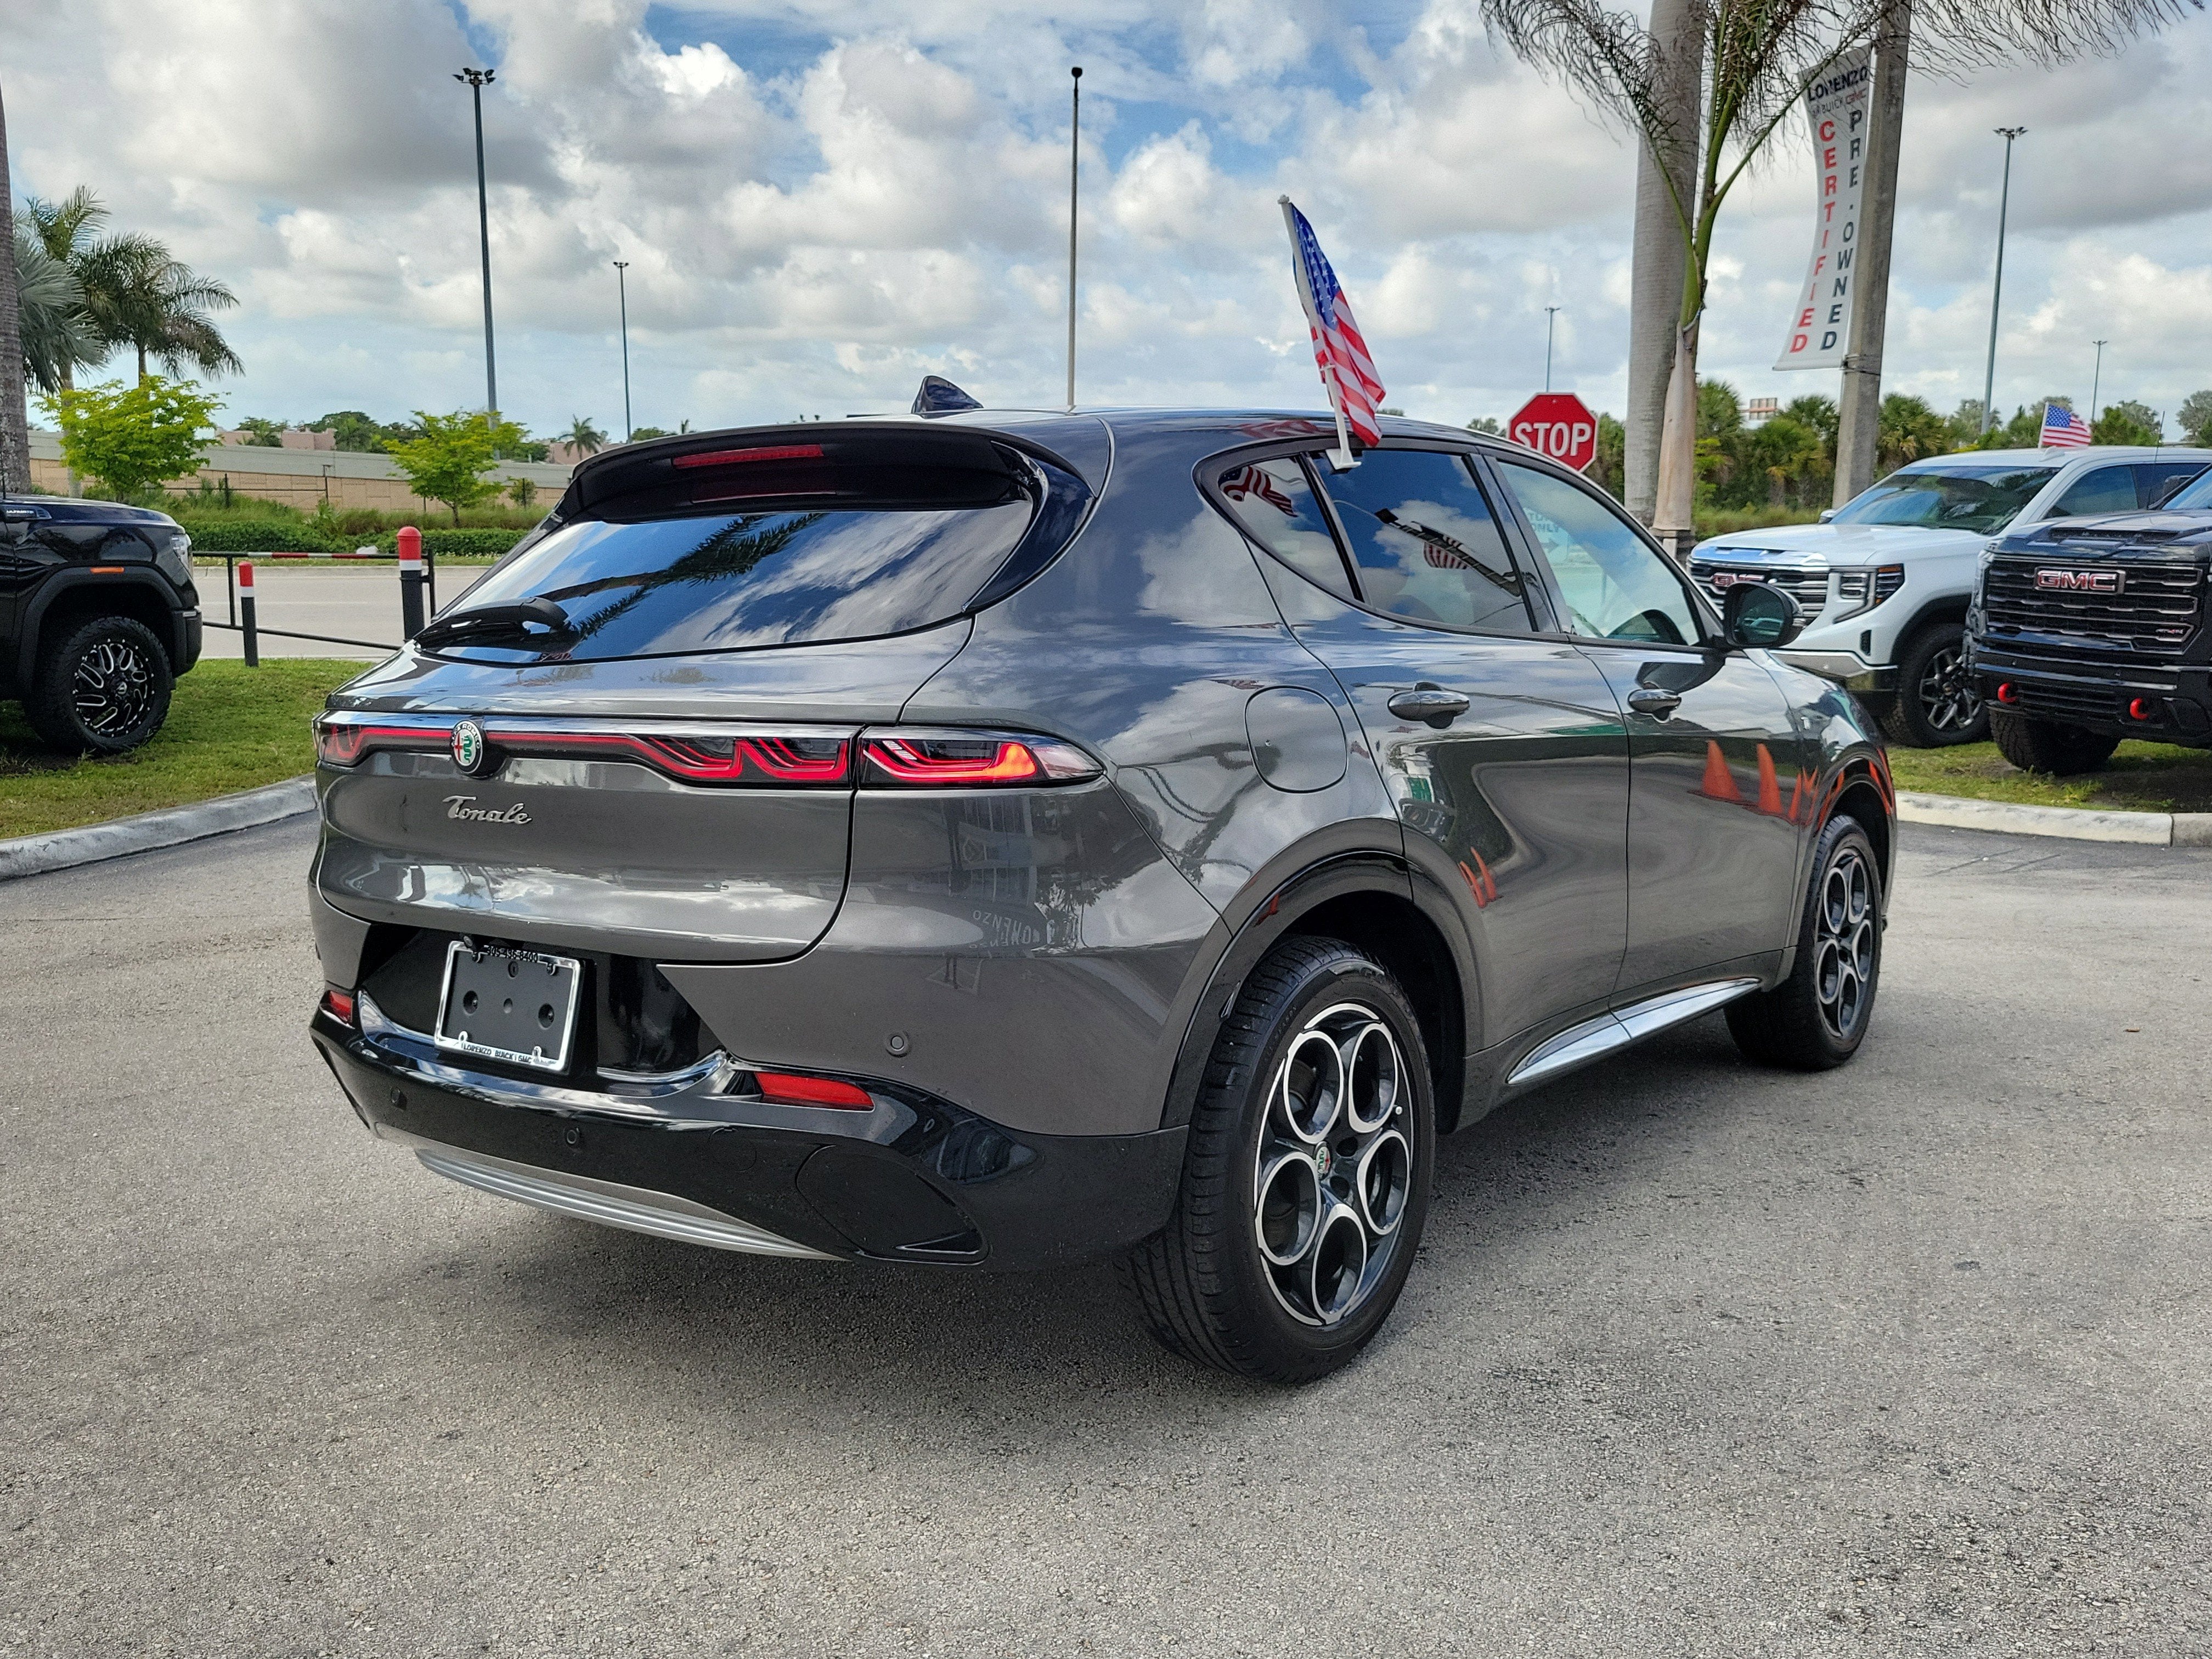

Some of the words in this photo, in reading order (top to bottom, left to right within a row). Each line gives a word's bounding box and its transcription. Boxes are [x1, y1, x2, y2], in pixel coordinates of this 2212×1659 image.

[1789, 120, 1837, 353] CERTIFIED
[1515, 421, 1592, 457] STOP
[2038, 569, 2117, 591] GMC
[462, 723, 481, 749] ROMEO
[443, 795, 532, 824] Tonale
[463, 1043, 492, 1056] LORENZO
[495, 1049, 513, 1060] BUICK
